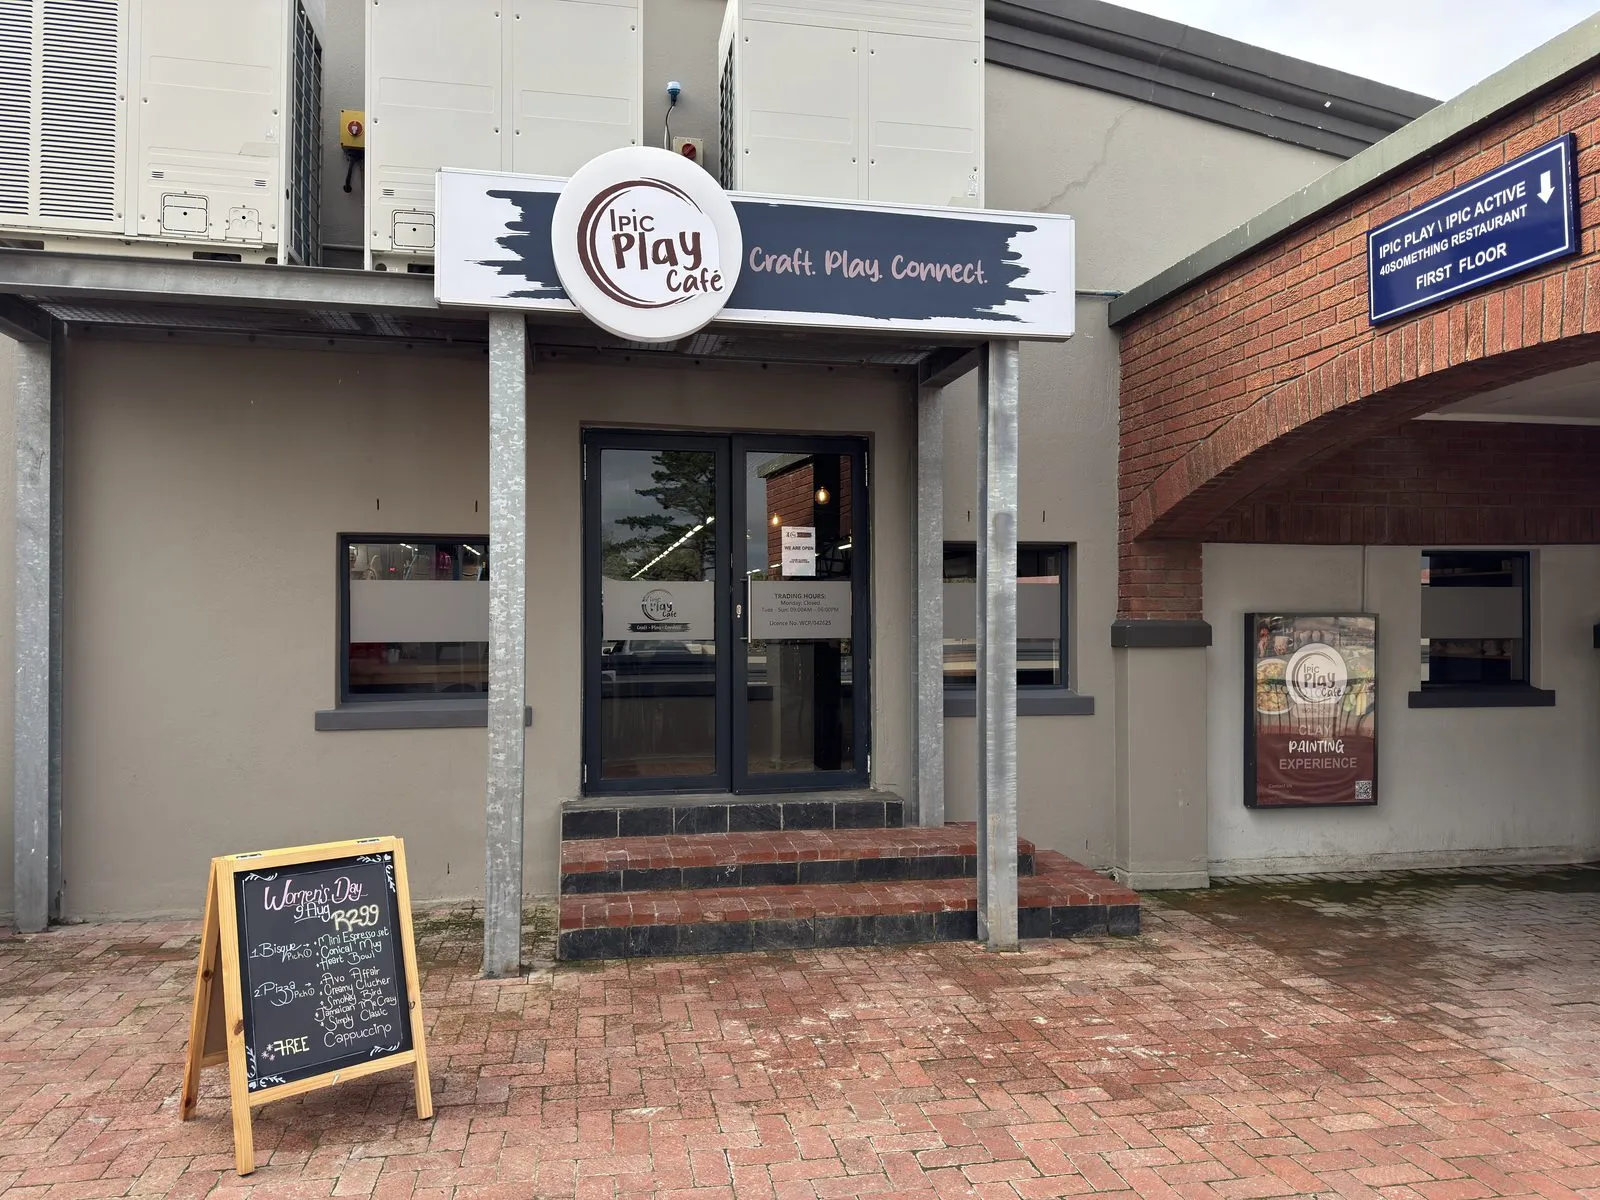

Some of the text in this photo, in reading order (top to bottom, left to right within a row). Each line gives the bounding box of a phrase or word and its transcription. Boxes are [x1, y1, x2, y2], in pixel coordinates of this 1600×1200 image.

[1379, 239, 1401, 258] IPIC
[1404, 222, 1435, 247] PLAY
[1446, 207, 1470, 229] IPIC
[1474, 181, 1526, 217] ACTIVE
[1379, 204, 1527, 276] 40SOMETHING RESTAURANT
[612, 231, 702, 271] Play
[750, 246, 988, 285] Craft. Play. Connect.
[1416, 242, 1507, 290] FIRST FLOOR
[666, 267, 723, 292] Café
[1304, 672, 1335, 688] Play
[1299, 724, 1331, 736] CLAY
[1289, 739, 1344, 754] PAINTING
[1279, 757, 1358, 770] EXPERIENCE
[264, 876, 364, 910] Women's Day
[294, 901, 330, 922] 9 Aug
[331, 904, 380, 932] R299
[318, 926, 390, 946] Mini Espresso set
[259, 942, 302, 963] Bisque
[320, 939, 382, 959] Conical Mug
[320, 950, 375, 971] Heart Bowl
[321, 966, 380, 985] Avo Affair
[258, 981, 296, 1007] Pizza
[324, 983, 354, 996] Creamy
[360, 988, 382, 1000] Bird
[314, 1004, 355, 1022] Jamaican
[325, 1008, 388, 1031] Simply Classic
[273, 1036, 310, 1056] FREE
[323, 1023, 392, 1048] Cappuccino
